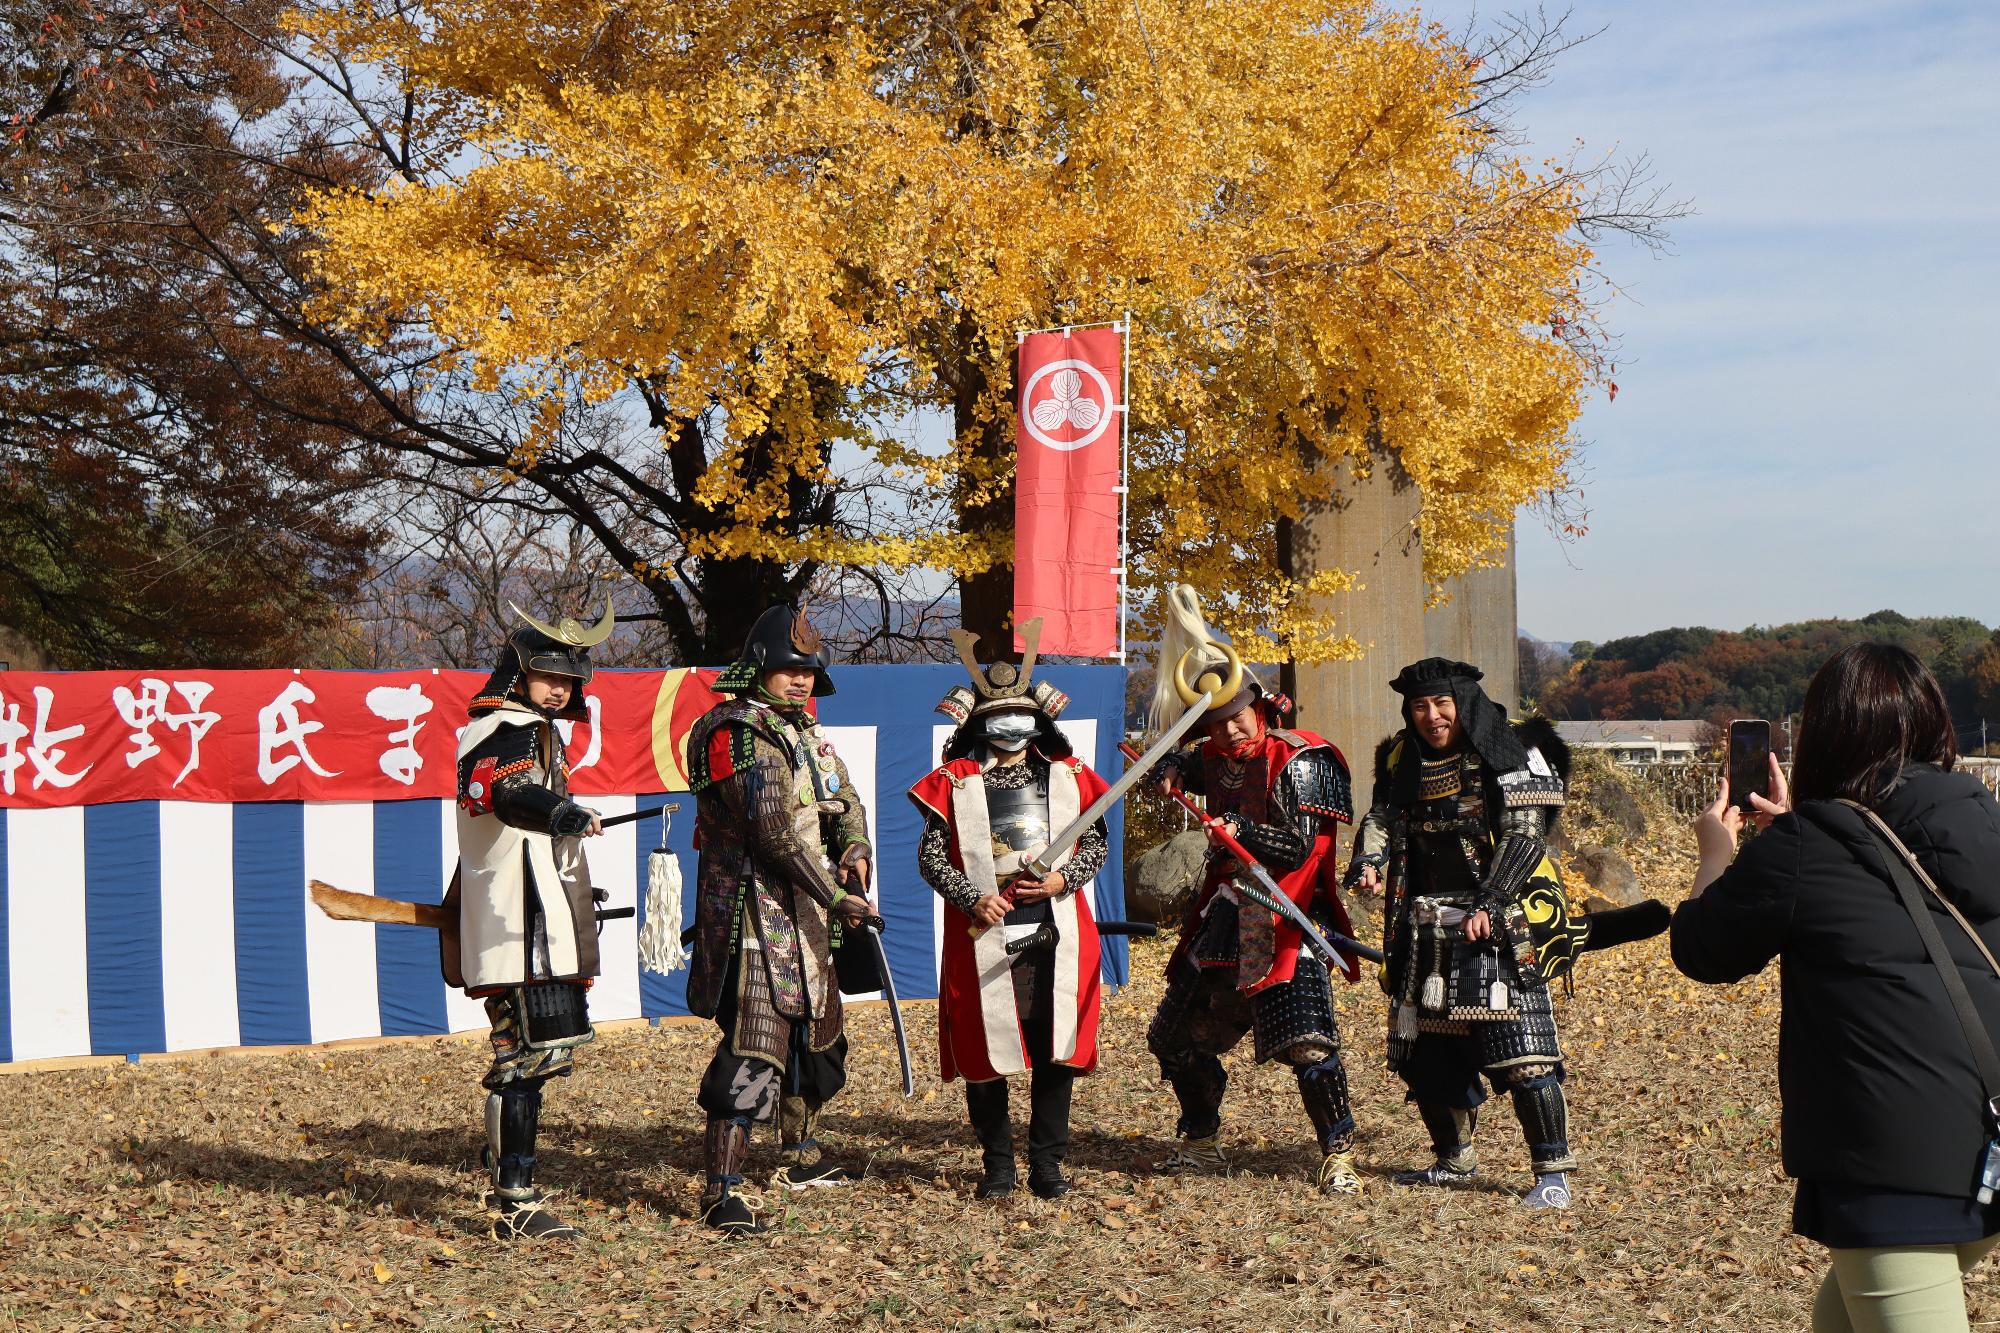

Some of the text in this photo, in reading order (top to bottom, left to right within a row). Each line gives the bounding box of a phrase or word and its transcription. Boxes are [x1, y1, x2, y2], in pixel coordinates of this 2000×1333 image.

[0, 678, 602, 795] 牧野氏まり
